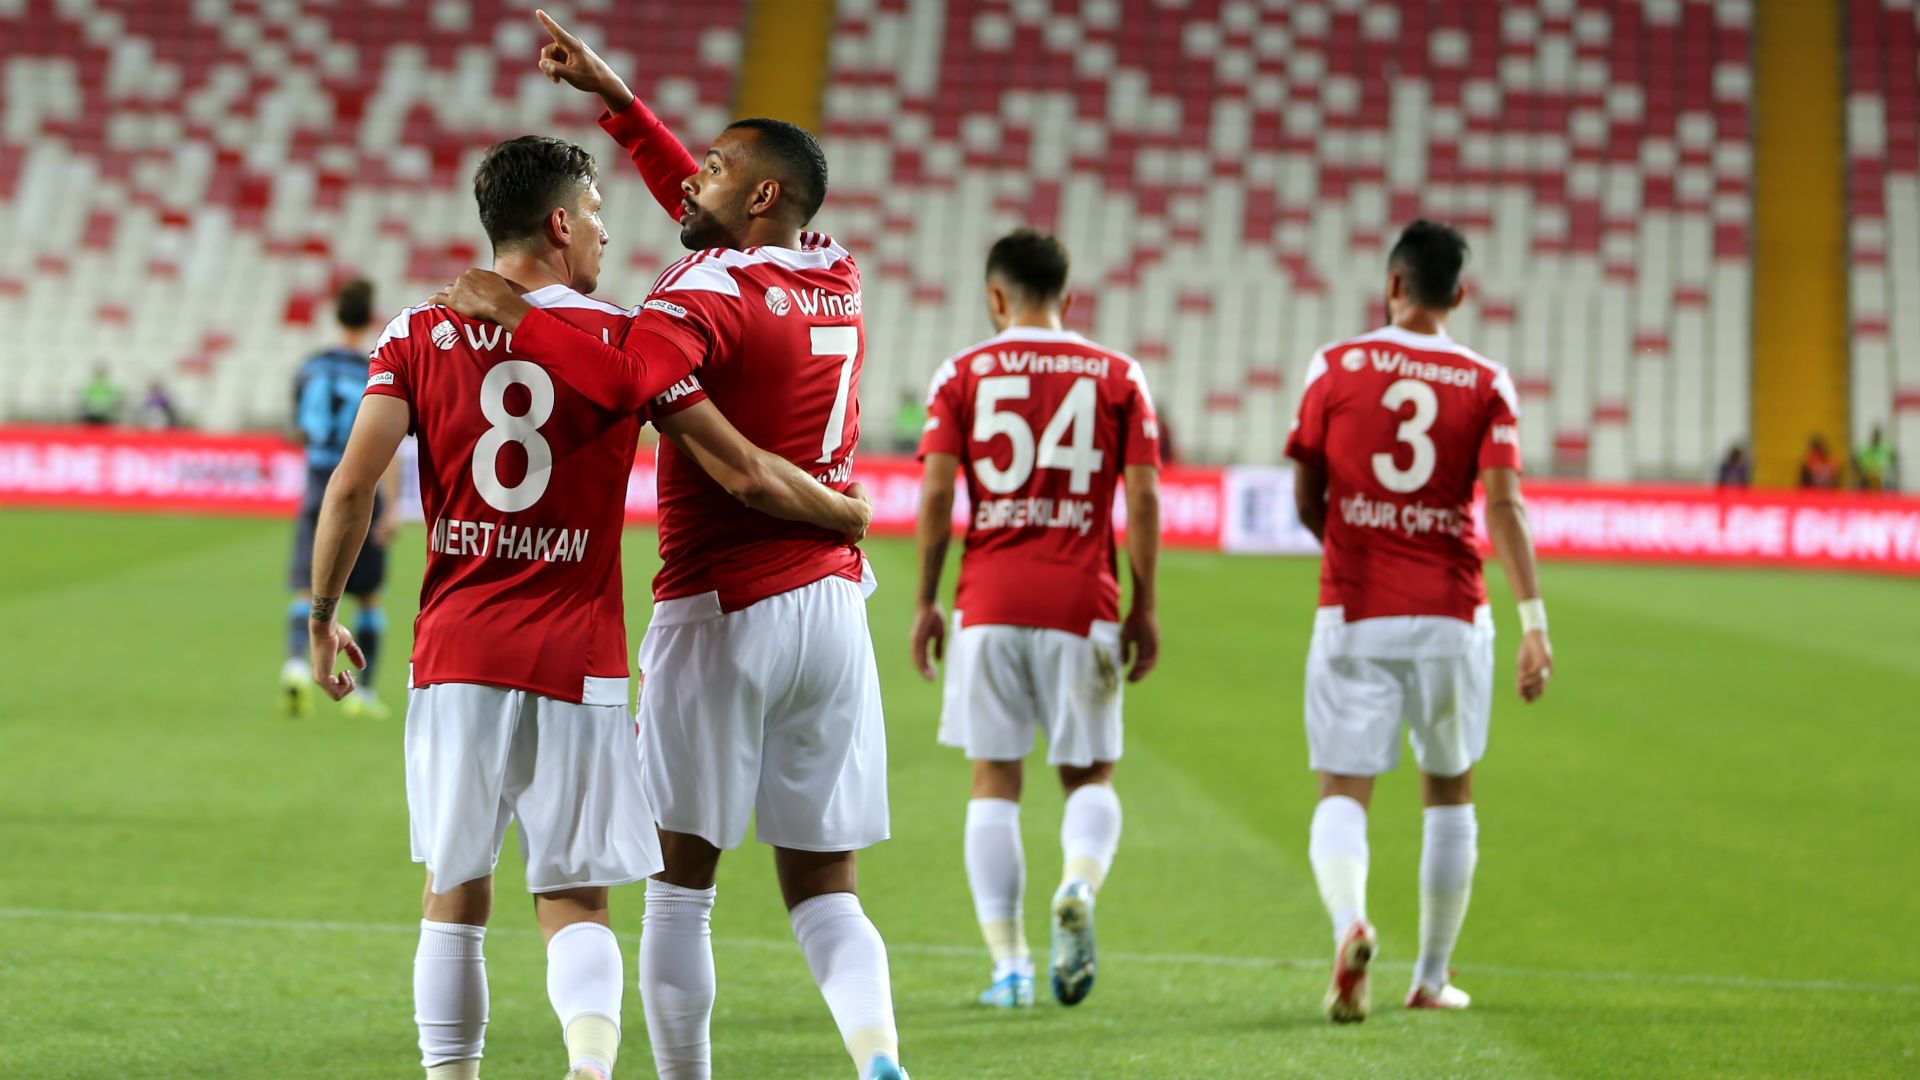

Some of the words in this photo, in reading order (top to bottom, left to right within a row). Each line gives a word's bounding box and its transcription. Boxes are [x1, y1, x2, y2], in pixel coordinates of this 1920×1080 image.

[789, 287, 862, 317] Winas
[809, 326, 859, 464] 7
[998, 351, 1110, 379] Winasol
[1370, 348, 1478, 389] Winasol
[472, 360, 555, 513] 8
[972, 375, 1104, 495] 54
[1371, 378, 1439, 494] 3
[431, 518, 496, 557] MERT
[496, 525, 589, 563] HAKAN
